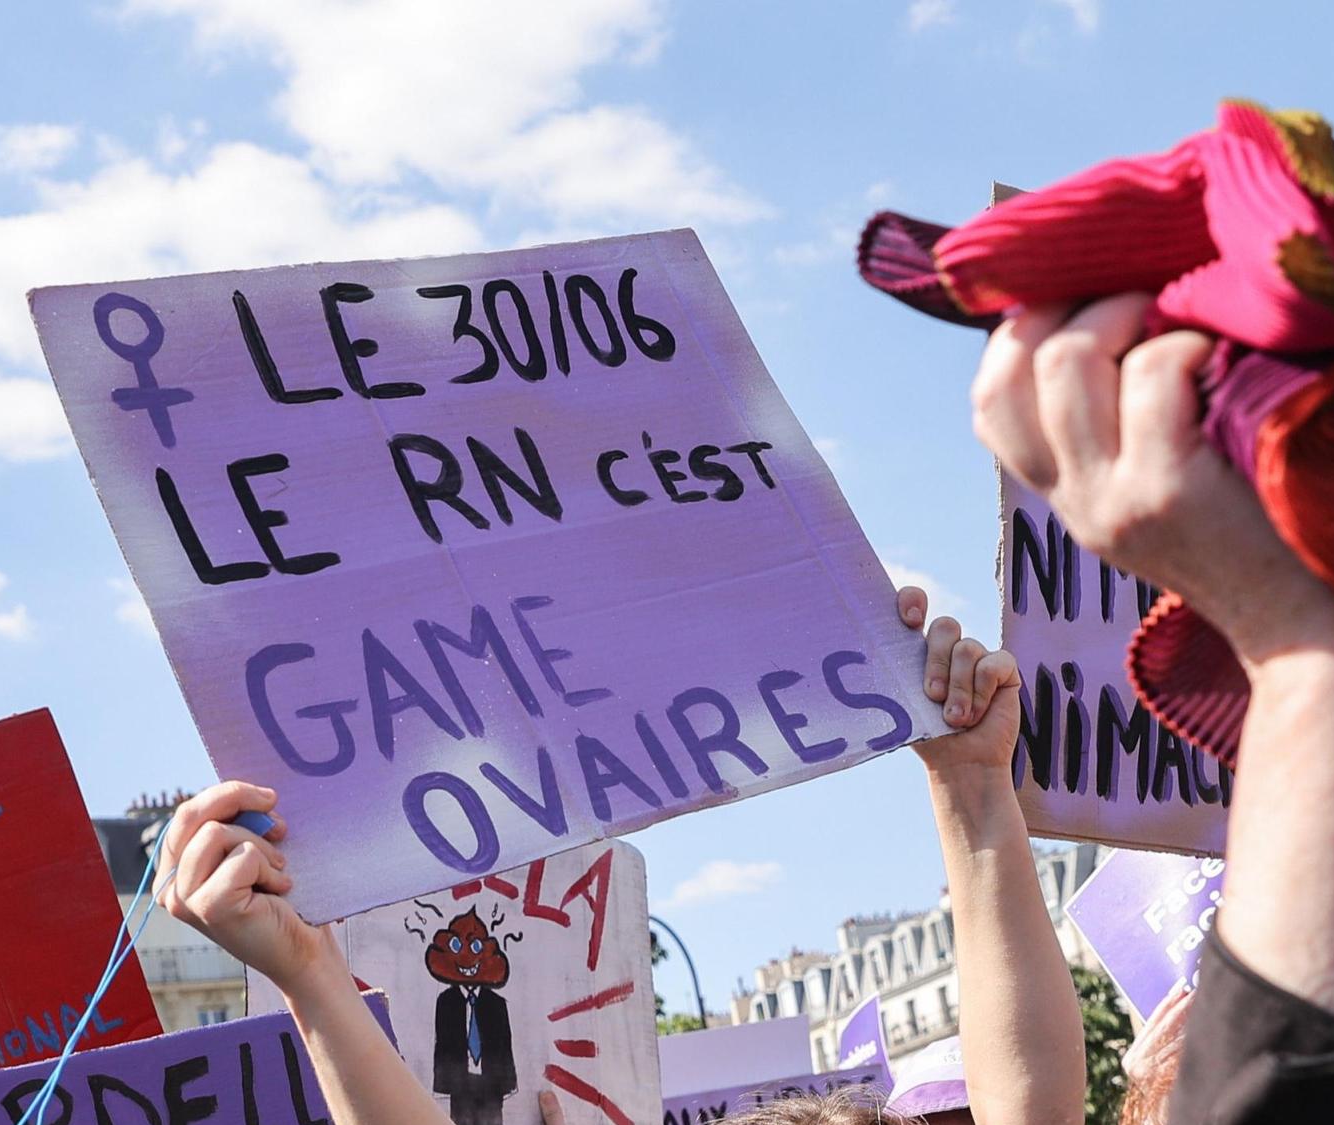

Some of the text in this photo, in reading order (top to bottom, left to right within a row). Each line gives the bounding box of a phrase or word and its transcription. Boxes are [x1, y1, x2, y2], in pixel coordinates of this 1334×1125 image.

[233, 268, 676, 404] LE 30/06
[156, 453, 340, 585] LE
[388, 426, 564, 545] RN
[245, 596, 612, 777] GAME
[401, 650, 915, 874] OVAIRES
[1141, 856, 1226, 935] Face
